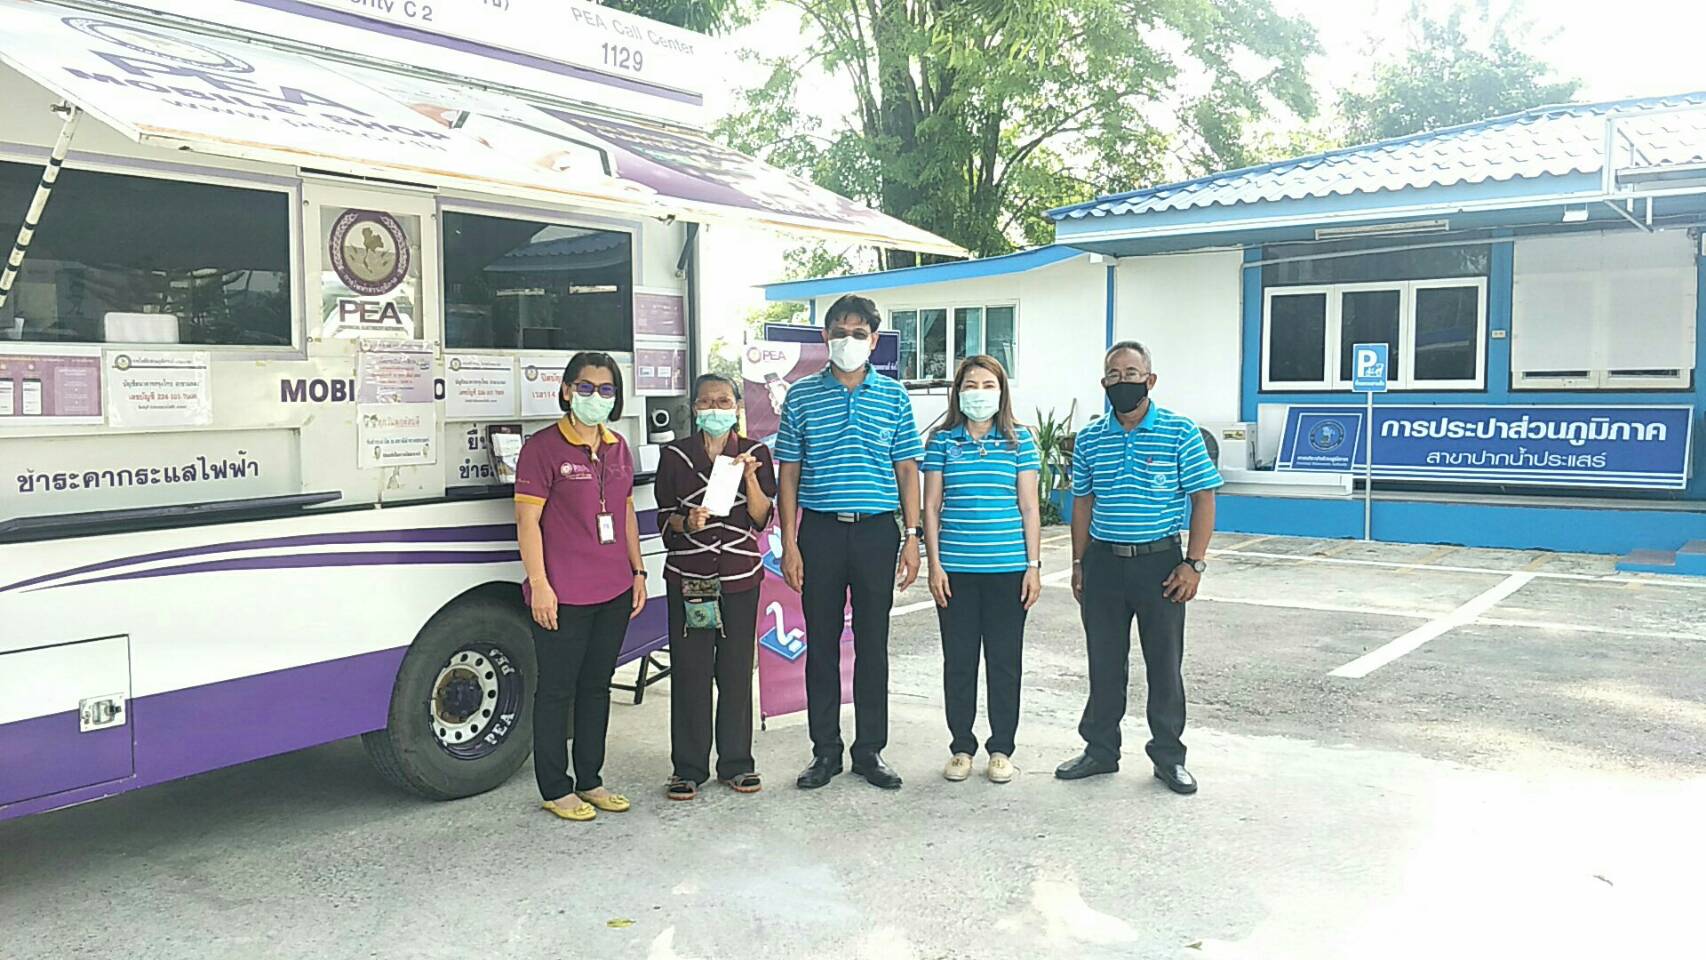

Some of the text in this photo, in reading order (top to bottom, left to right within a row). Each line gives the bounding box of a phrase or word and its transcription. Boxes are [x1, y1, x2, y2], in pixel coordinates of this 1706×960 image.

[570, 6, 695, 56] PEA Call Center
[601, 41, 644, 73] 1129
[87, 49, 375, 118] PEA
[61, 66, 451, 140] MOBILE SHOP
[339, 299, 403, 325] PEA
[762, 350, 787, 361] PEA
[280, 379, 355, 402] MOBI
[1381, 415, 1667, 446] การประปาส่วนภูมิภาค
[1426, 447, 1607, 468] สาขาปากน้ำประแสร์
[483, 712, 516, 745] PEA
